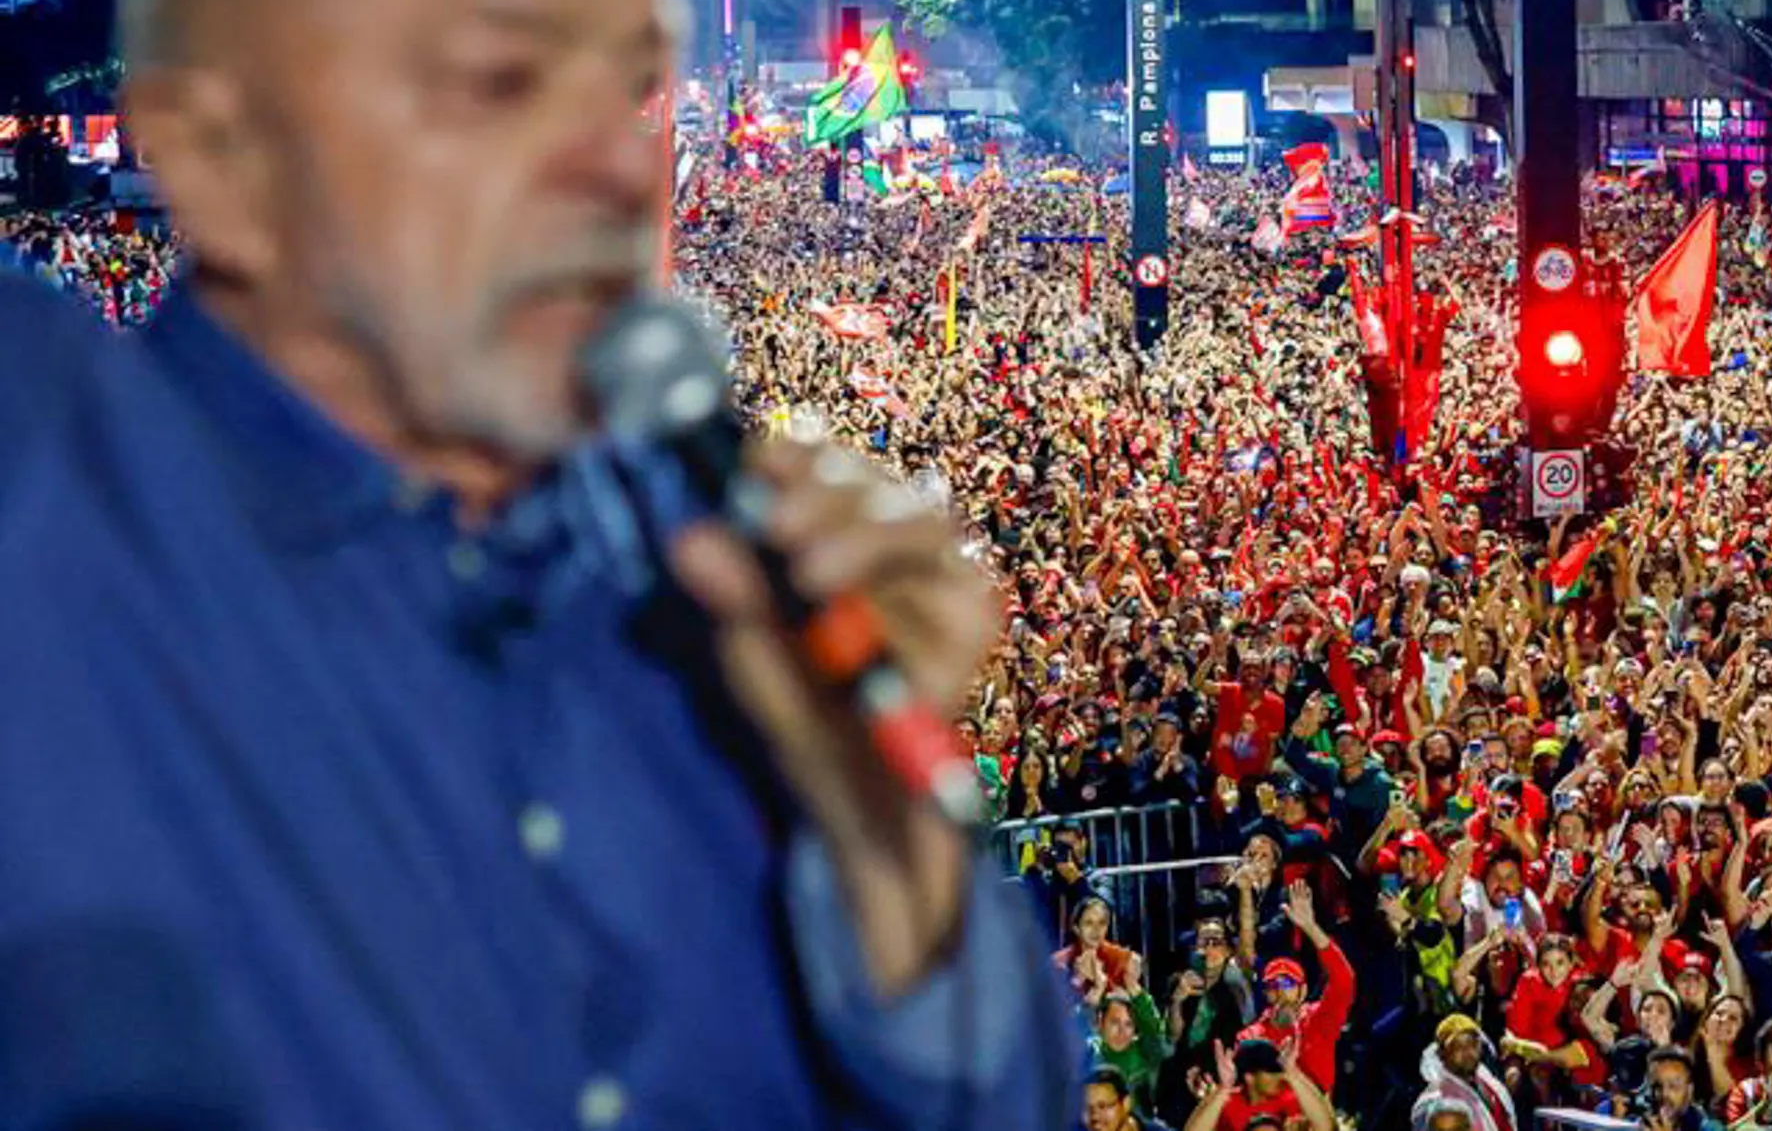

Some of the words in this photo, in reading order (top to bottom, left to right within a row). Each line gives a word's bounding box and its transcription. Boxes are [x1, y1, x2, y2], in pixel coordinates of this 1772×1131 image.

[1139, 1, 1161, 111] Pamplona
[1140, 122, 1159, 146] R.
[1546, 463, 1573, 485] 20
